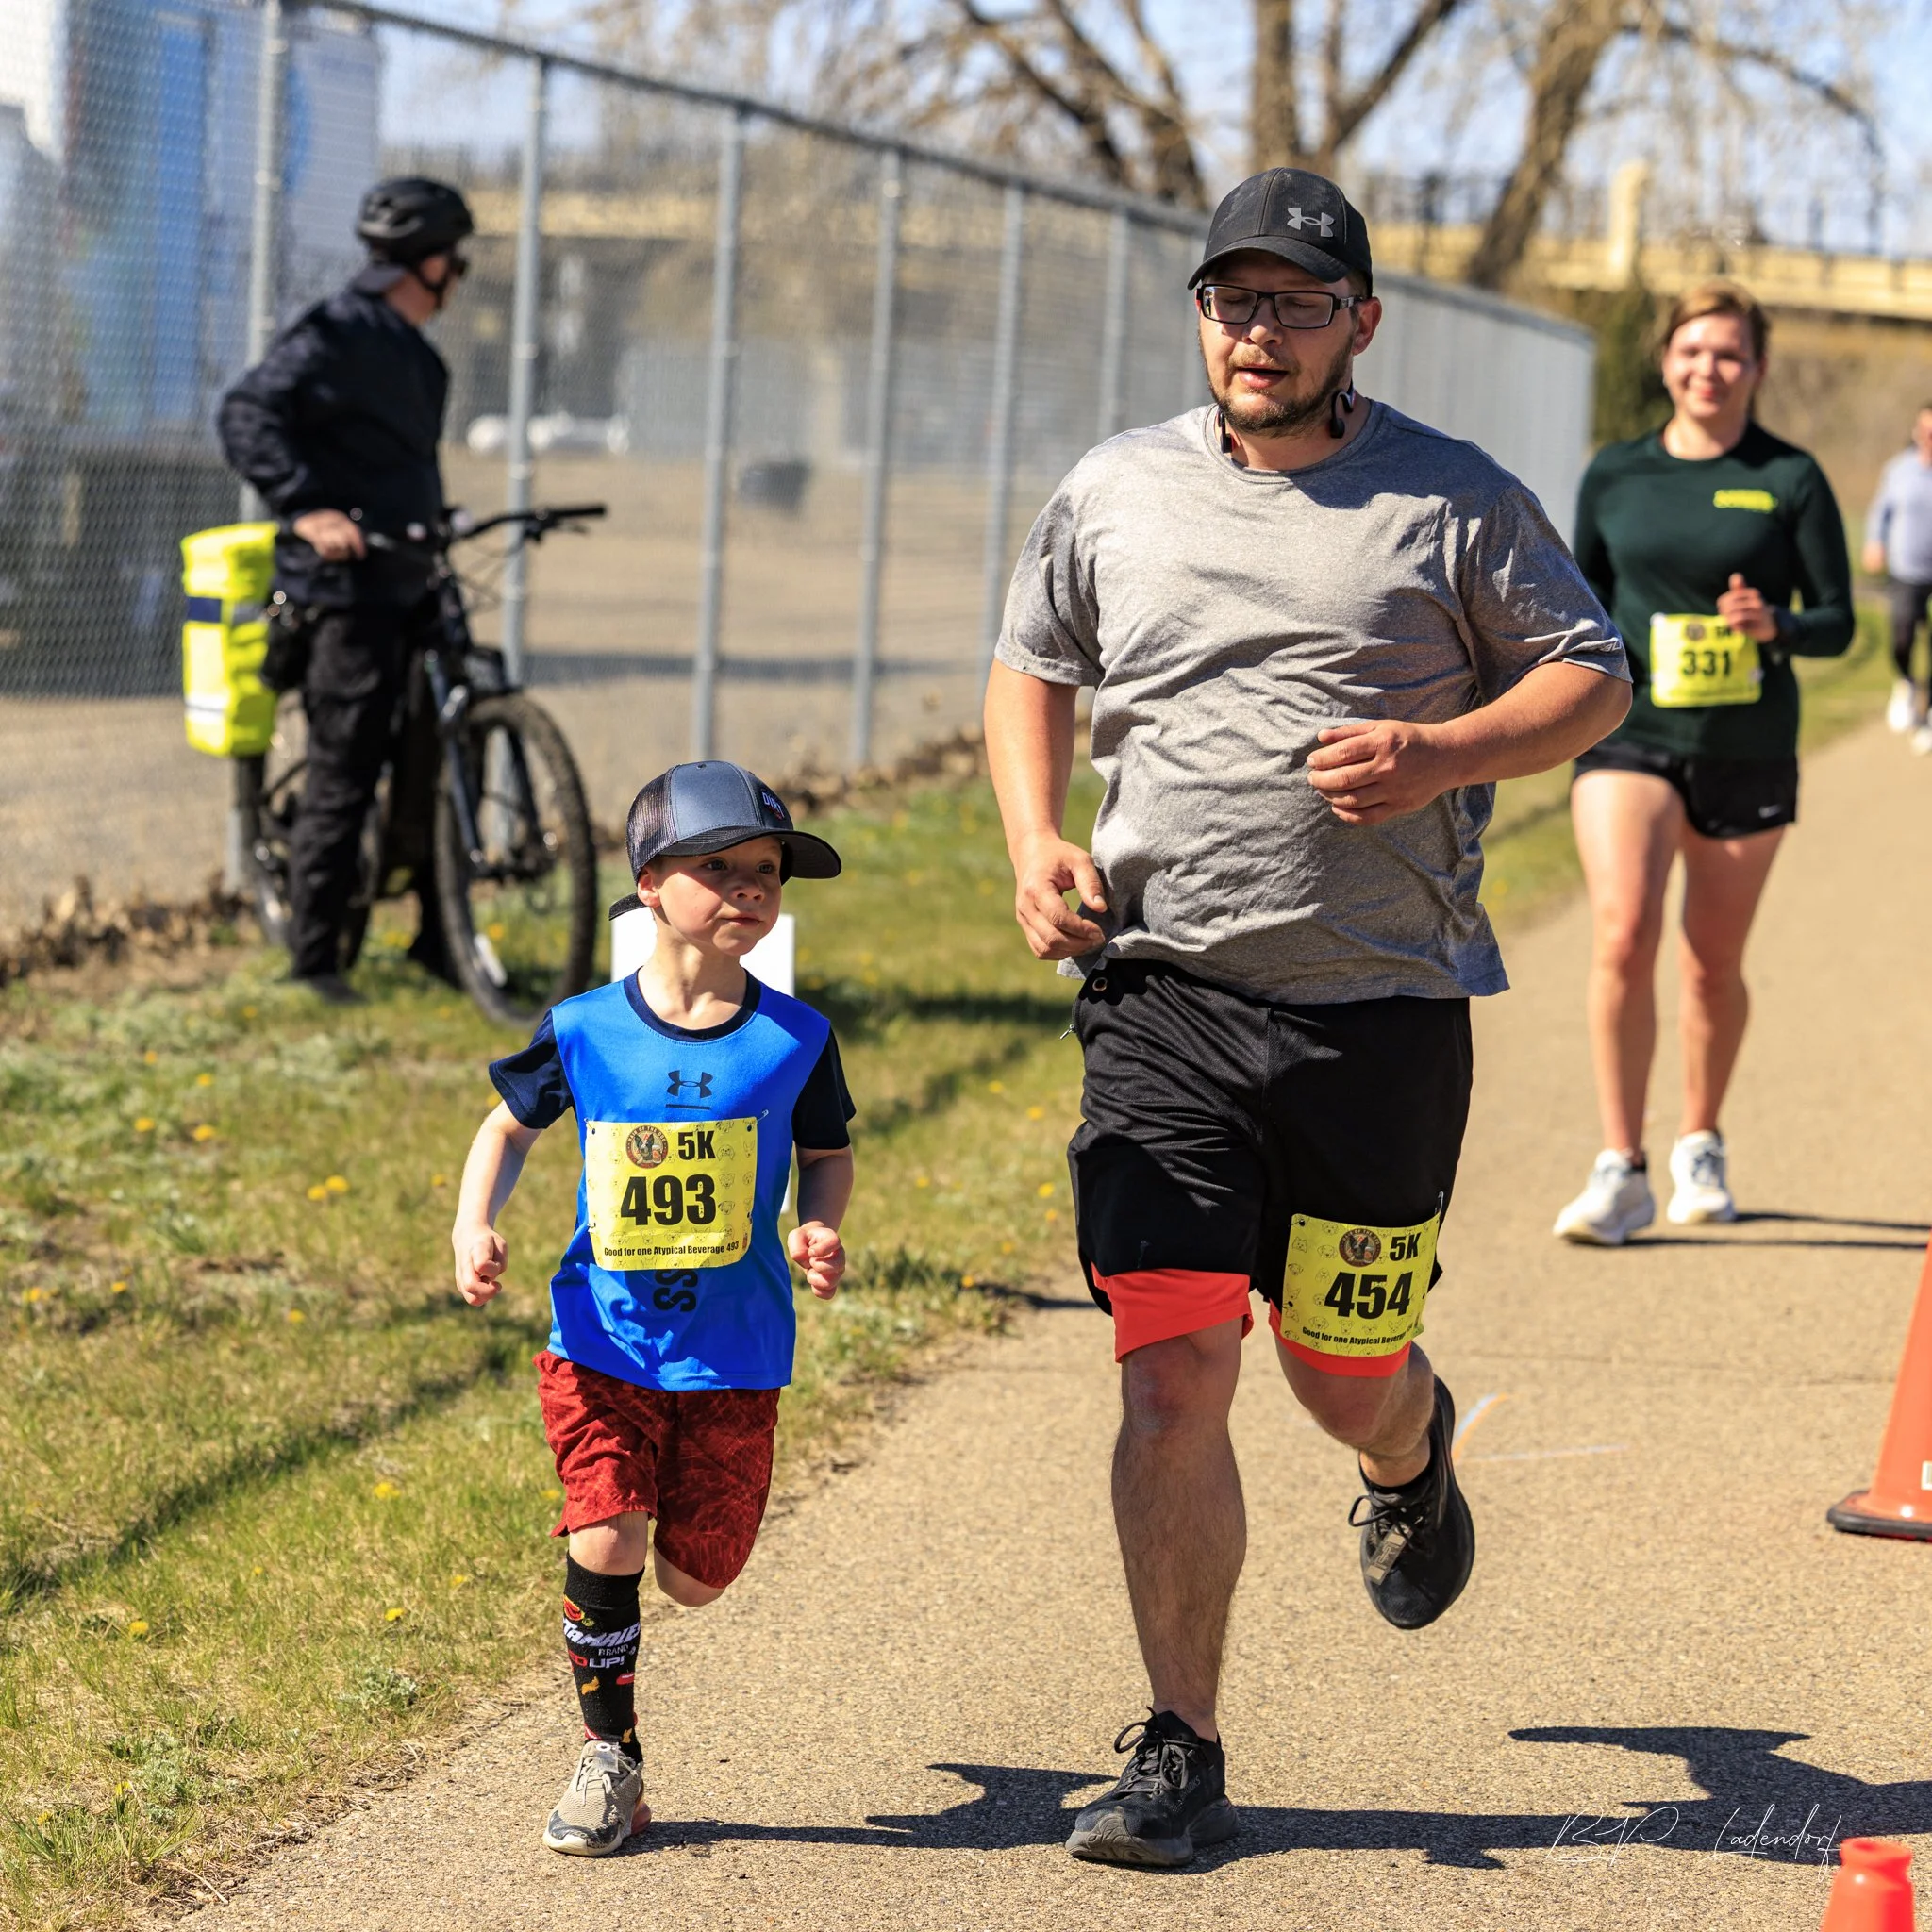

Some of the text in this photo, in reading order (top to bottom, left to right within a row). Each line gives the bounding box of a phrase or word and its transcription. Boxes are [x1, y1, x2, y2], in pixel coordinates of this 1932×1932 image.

[1683, 649, 1731, 677] 331
[678, 1130, 716, 1160] 5K
[620, 1174, 716, 1226] 493
[604, 1247, 623, 1257] Good
[624, 1247, 635, 1257] for
[654, 1244, 686, 1257] Atypical
[688, 1244, 725, 1256] Beverage
[726, 1241, 739, 1252] 493
[1389, 1232, 1422, 1262] 5K
[1324, 1271, 1414, 1320] 454
[1302, 1326, 1320, 1339] Good
[1321, 1331, 1332, 1341] for
[1333, 1336, 1348, 1344] one
[1349, 1336, 1380, 1345] Atypical
[589, 1656, 625, 1669] UP!
[598, 1644, 629, 1657] BRAND
